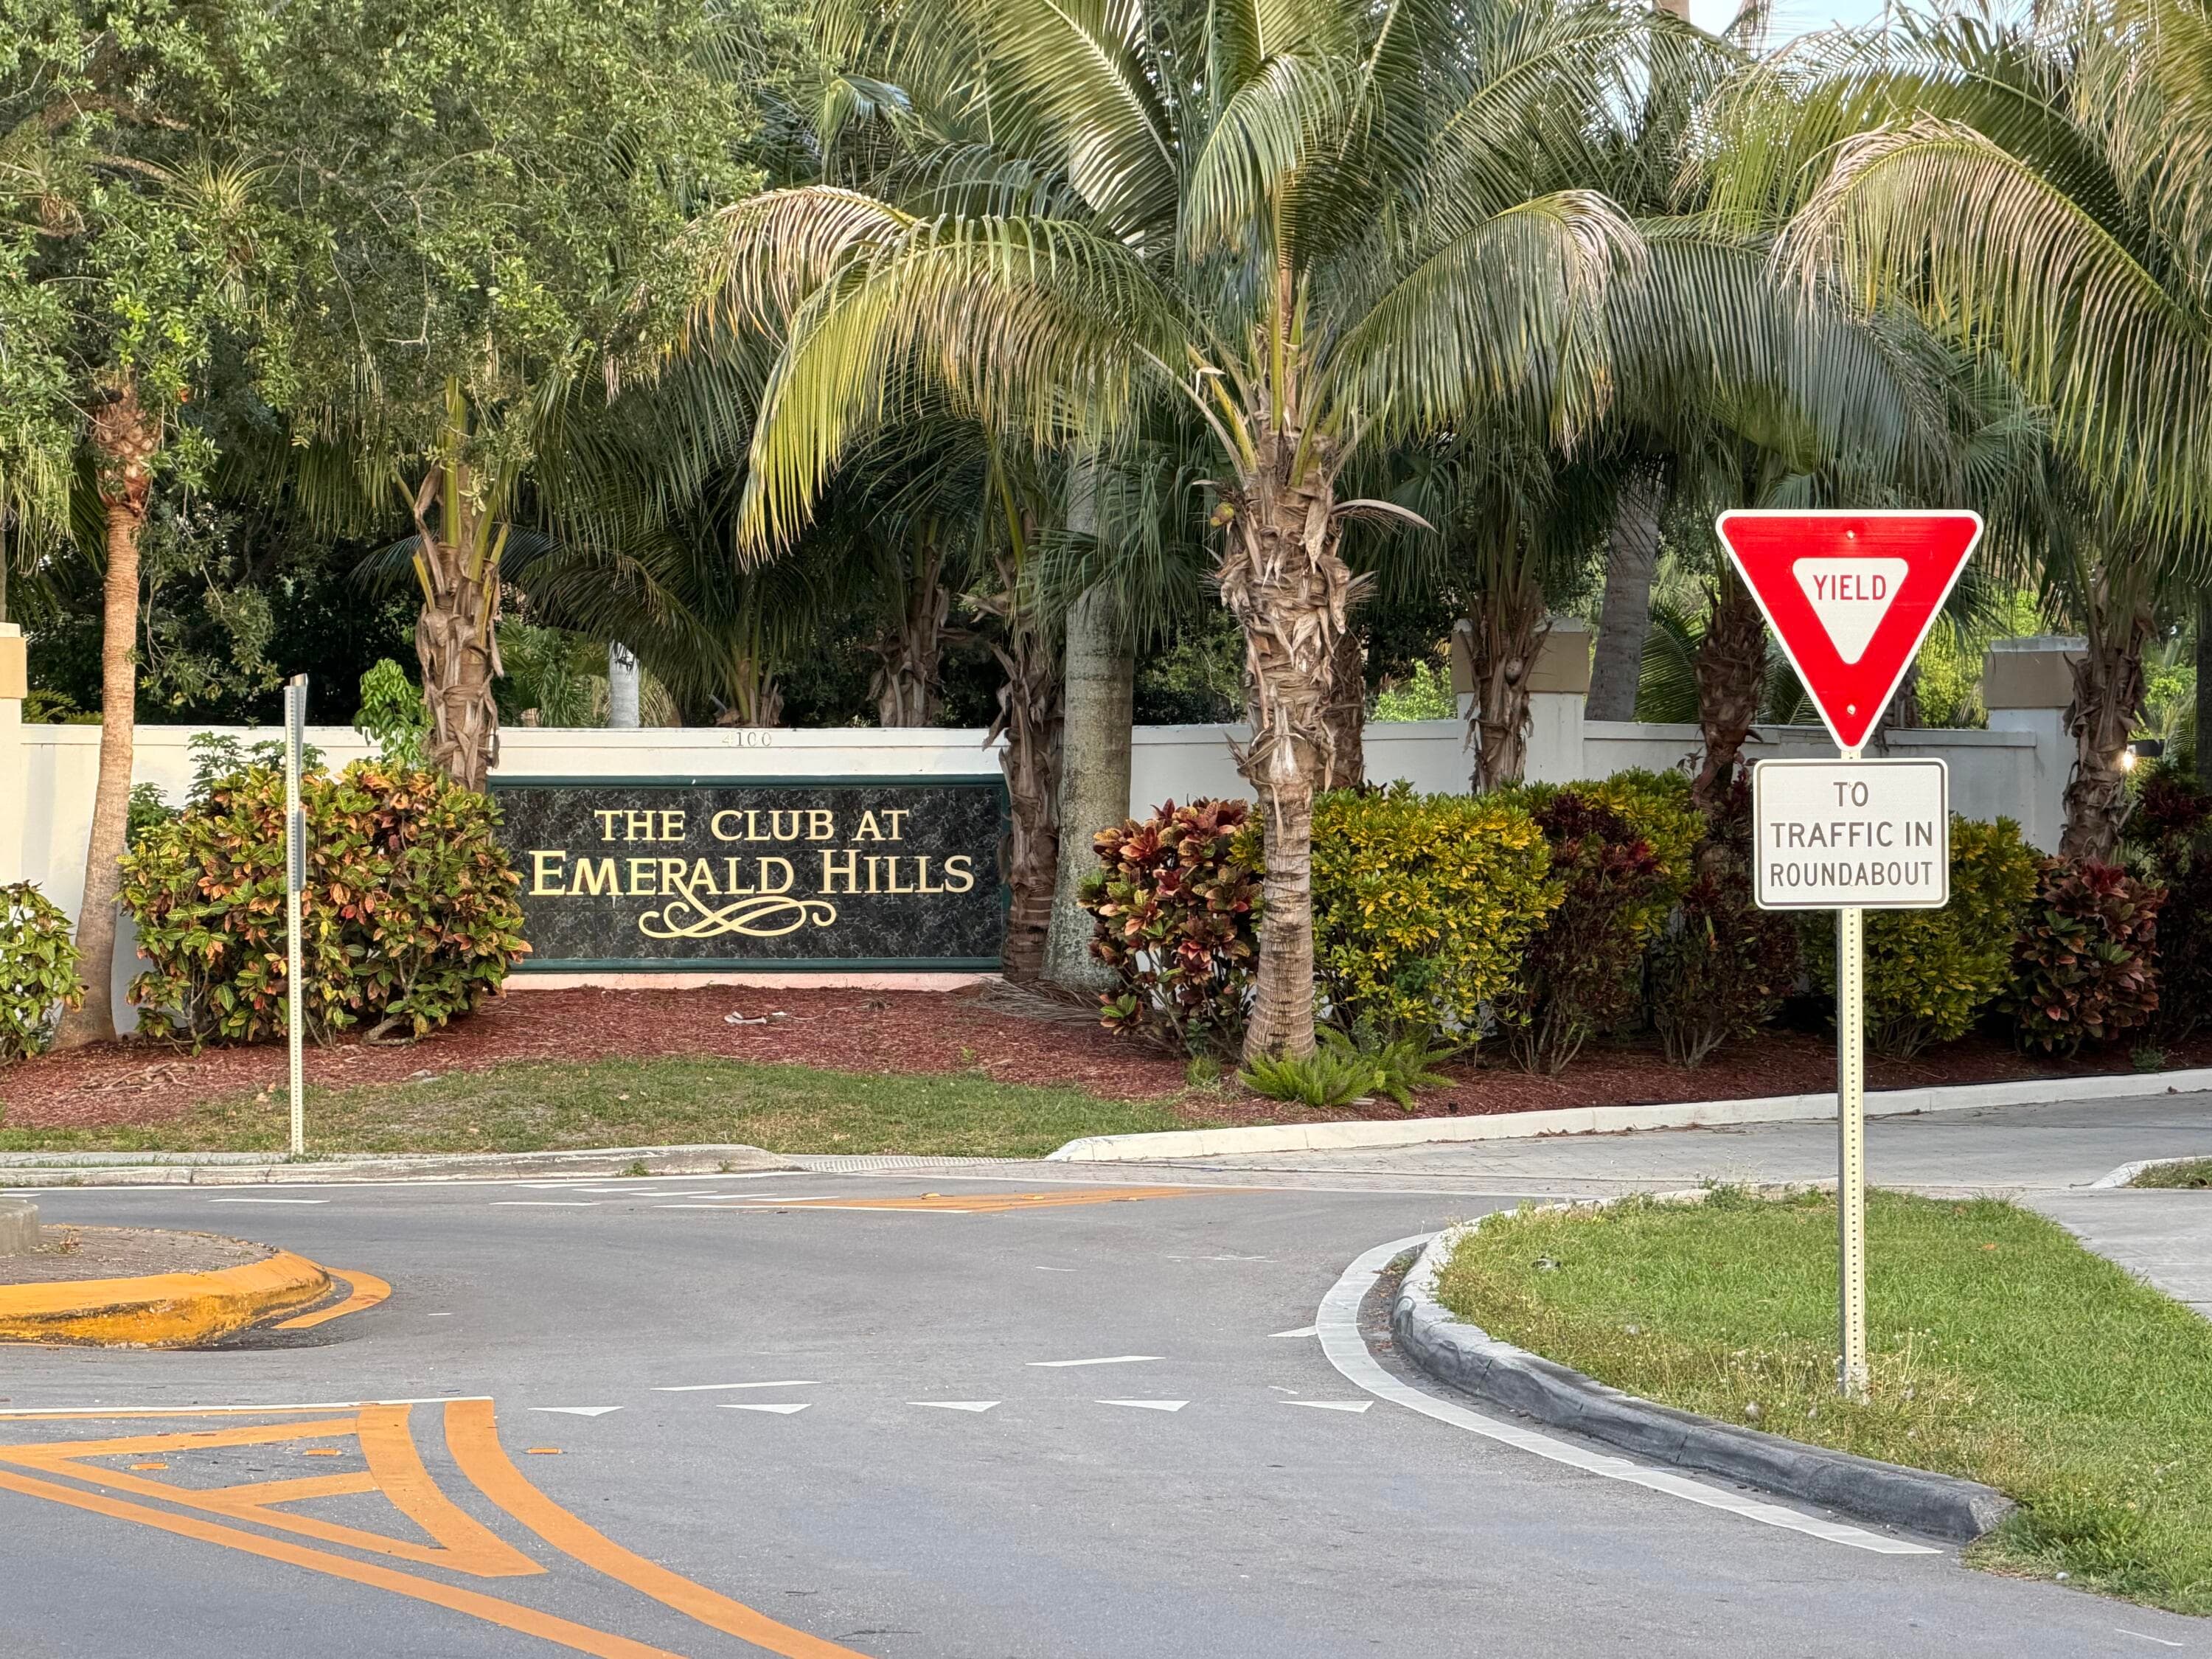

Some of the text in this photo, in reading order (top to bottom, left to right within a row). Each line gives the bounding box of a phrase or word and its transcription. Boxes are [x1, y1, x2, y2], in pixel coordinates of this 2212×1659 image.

[1813, 574, 1887, 601] YIELD
[720, 731, 773, 747] 4100
[1833, 782, 1869, 807] TO
[594, 807, 911, 842] THE CLUB AT
[1770, 821, 1933, 848] TRAFFIC IN
[1770, 861, 1933, 887] ROUNDABOUT
